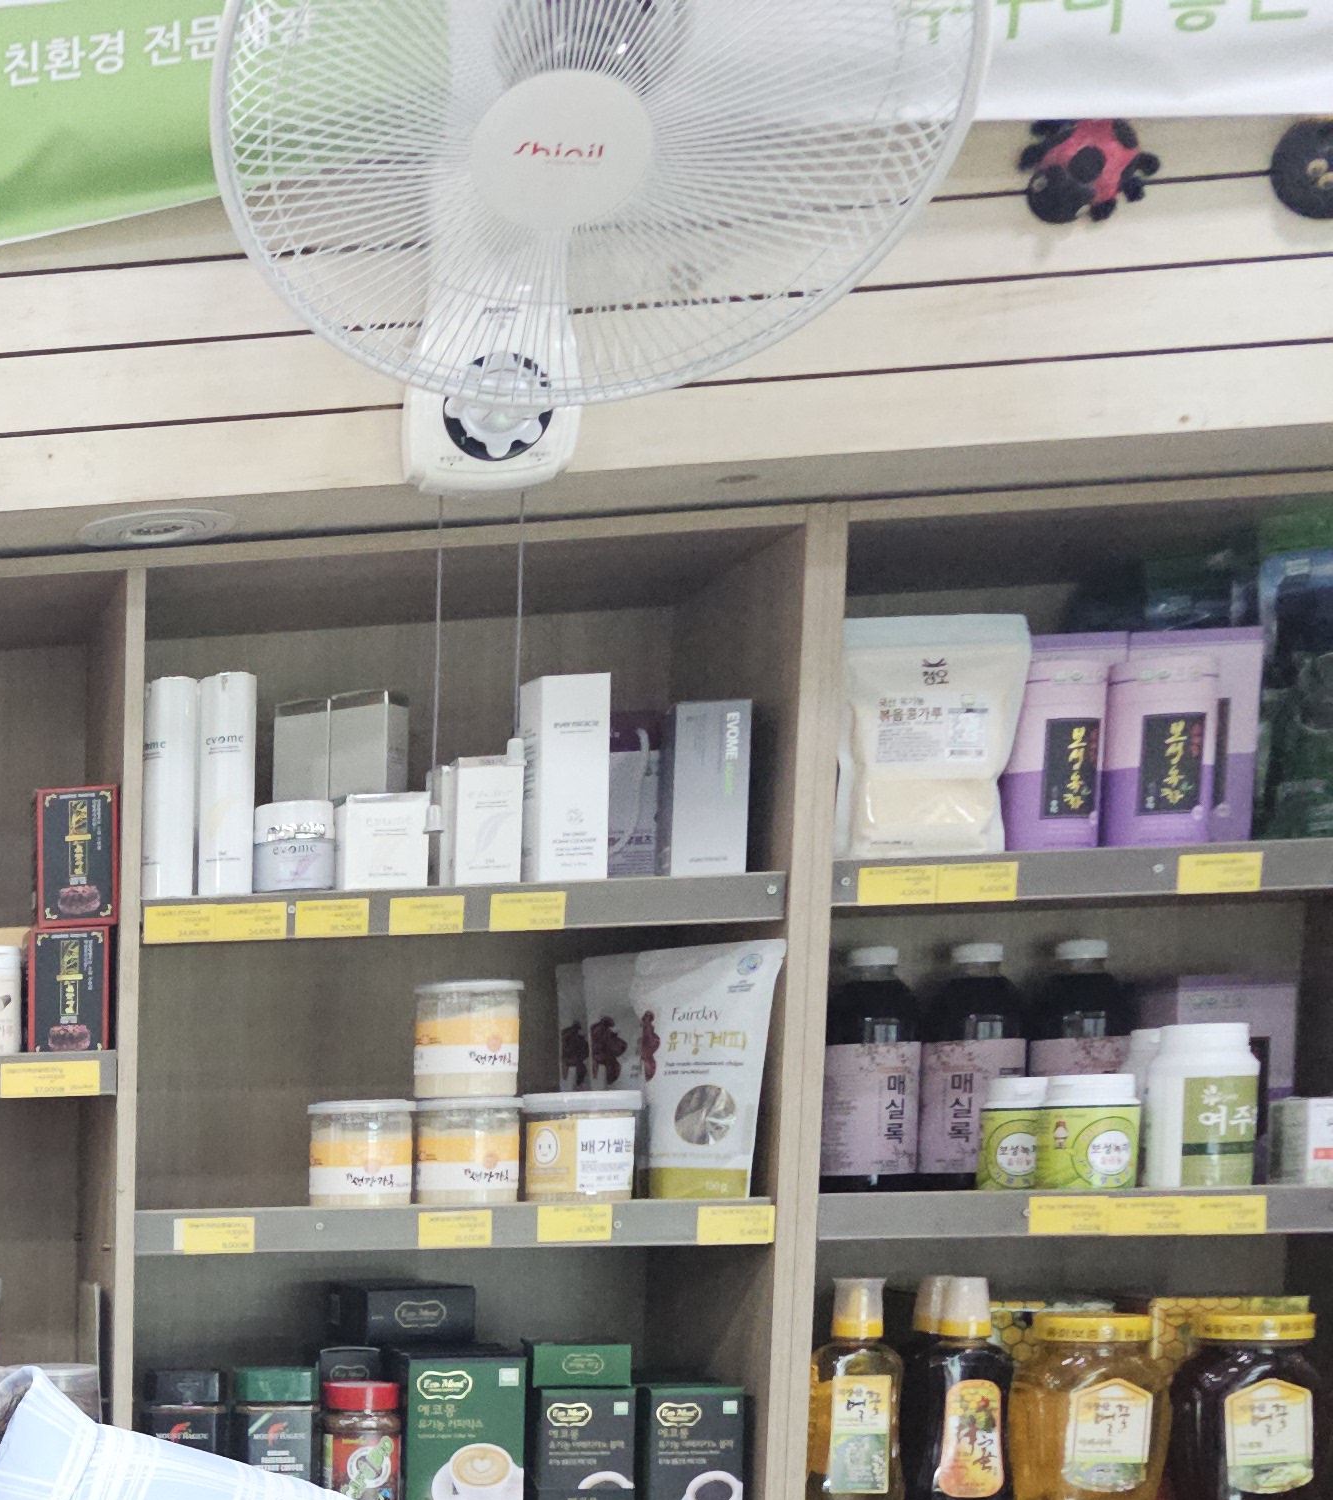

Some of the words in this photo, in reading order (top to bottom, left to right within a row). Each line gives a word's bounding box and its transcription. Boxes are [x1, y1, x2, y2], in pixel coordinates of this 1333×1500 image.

[3, 29, 126, 88] 친환경
[205, 733, 245, 745] evome
[725, 710, 740, 761] EVOME
[271, 842, 318, 856] evome
[670, 1006, 723, 1022] Fairday
[666, 1029, 702, 1055] 유기농
